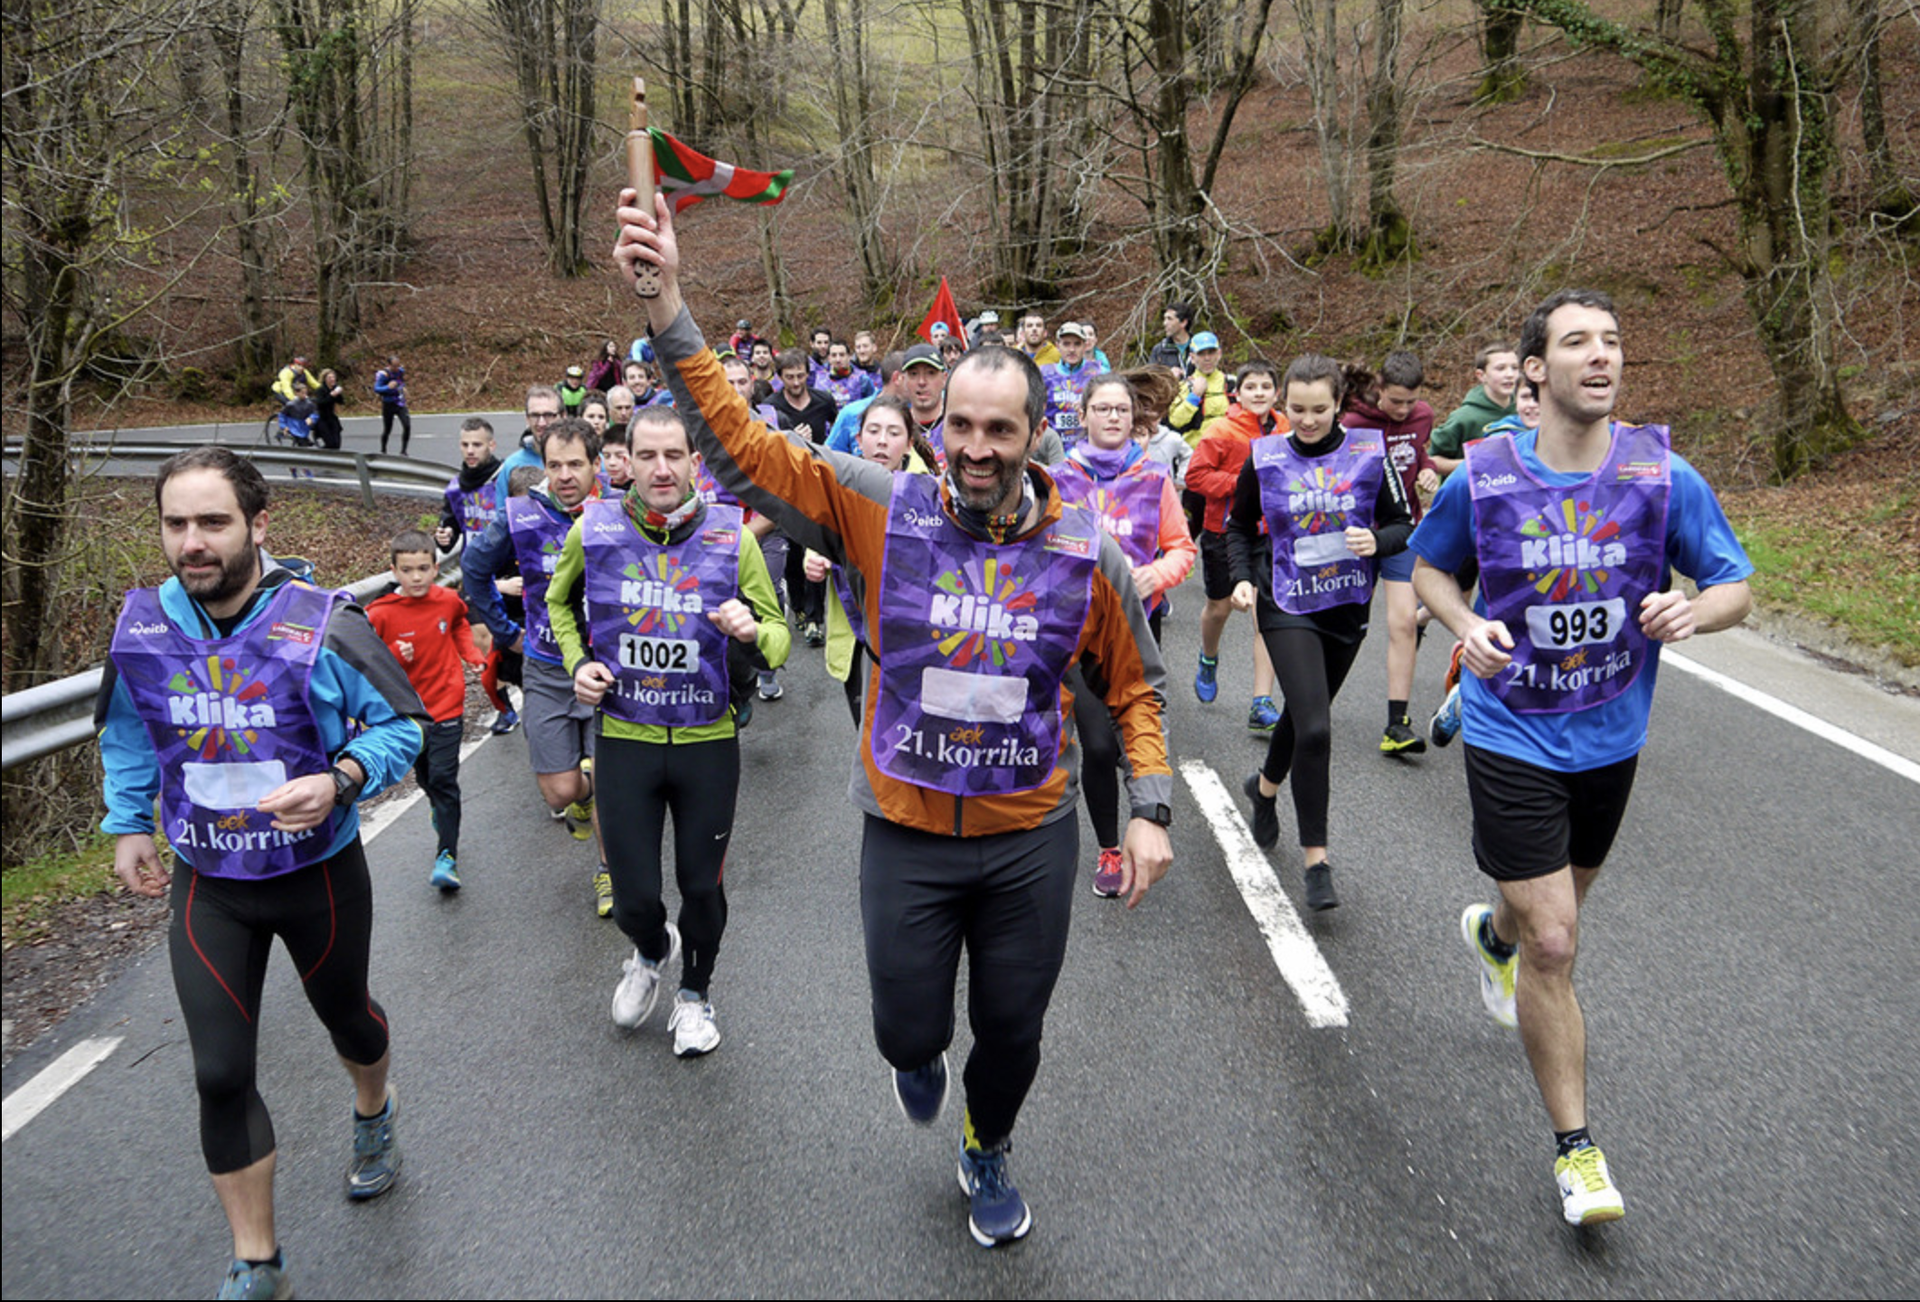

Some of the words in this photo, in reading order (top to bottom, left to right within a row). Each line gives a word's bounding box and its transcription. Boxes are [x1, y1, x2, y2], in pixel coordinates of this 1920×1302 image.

[1289, 489, 1357, 514] Klika
[918, 514, 943, 527] eitb
[1520, 533, 1627, 570] Klika
[620, 580, 702, 614] Klika
[1286, 578, 1311, 596] 21.
[929, 594, 1039, 641] Klika
[1550, 606, 1608, 646] 993
[627, 638, 688, 669] 1002
[1506, 661, 1546, 691] 21.
[1551, 649, 1632, 692] korrika
[633, 680, 714, 706] korrika
[168, 691, 277, 730] Klika
[893, 723, 933, 759] 21.
[937, 730, 1039, 767] korrika
[949, 723, 985, 745] aek
[175, 817, 207, 849] 21.
[217, 809, 249, 831] aek
